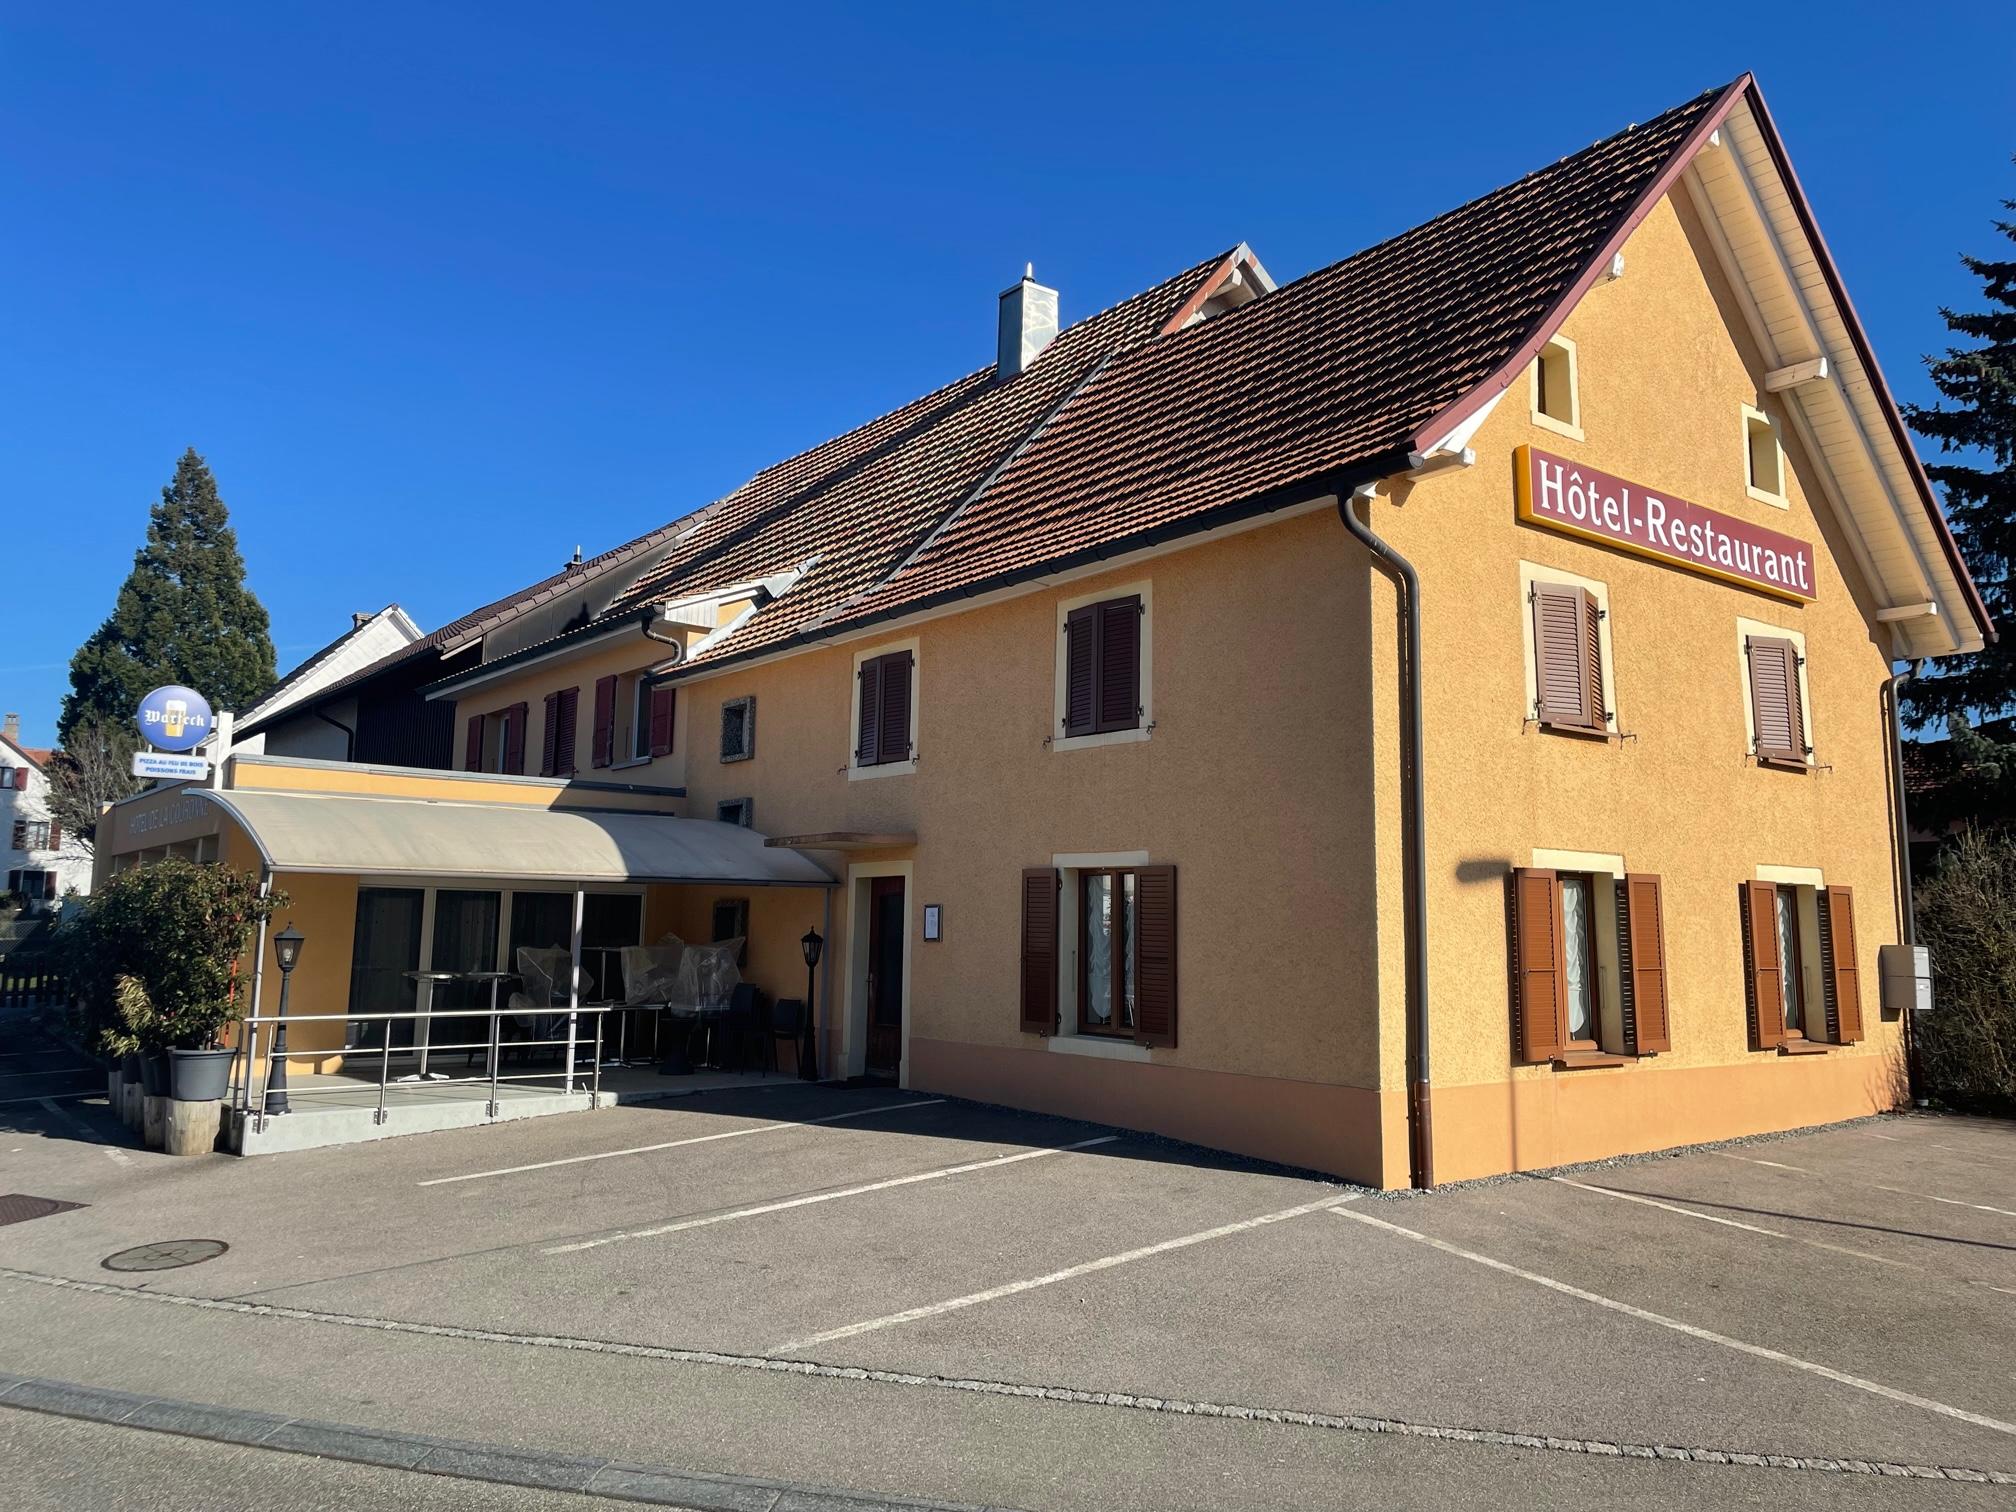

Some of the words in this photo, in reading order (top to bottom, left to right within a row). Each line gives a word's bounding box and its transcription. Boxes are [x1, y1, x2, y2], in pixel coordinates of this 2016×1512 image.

[1539, 459, 1809, 590] Hôtel-Restaurant
[144, 710, 205, 727] Warteck
[145, 766, 178, 774] POISSONS
